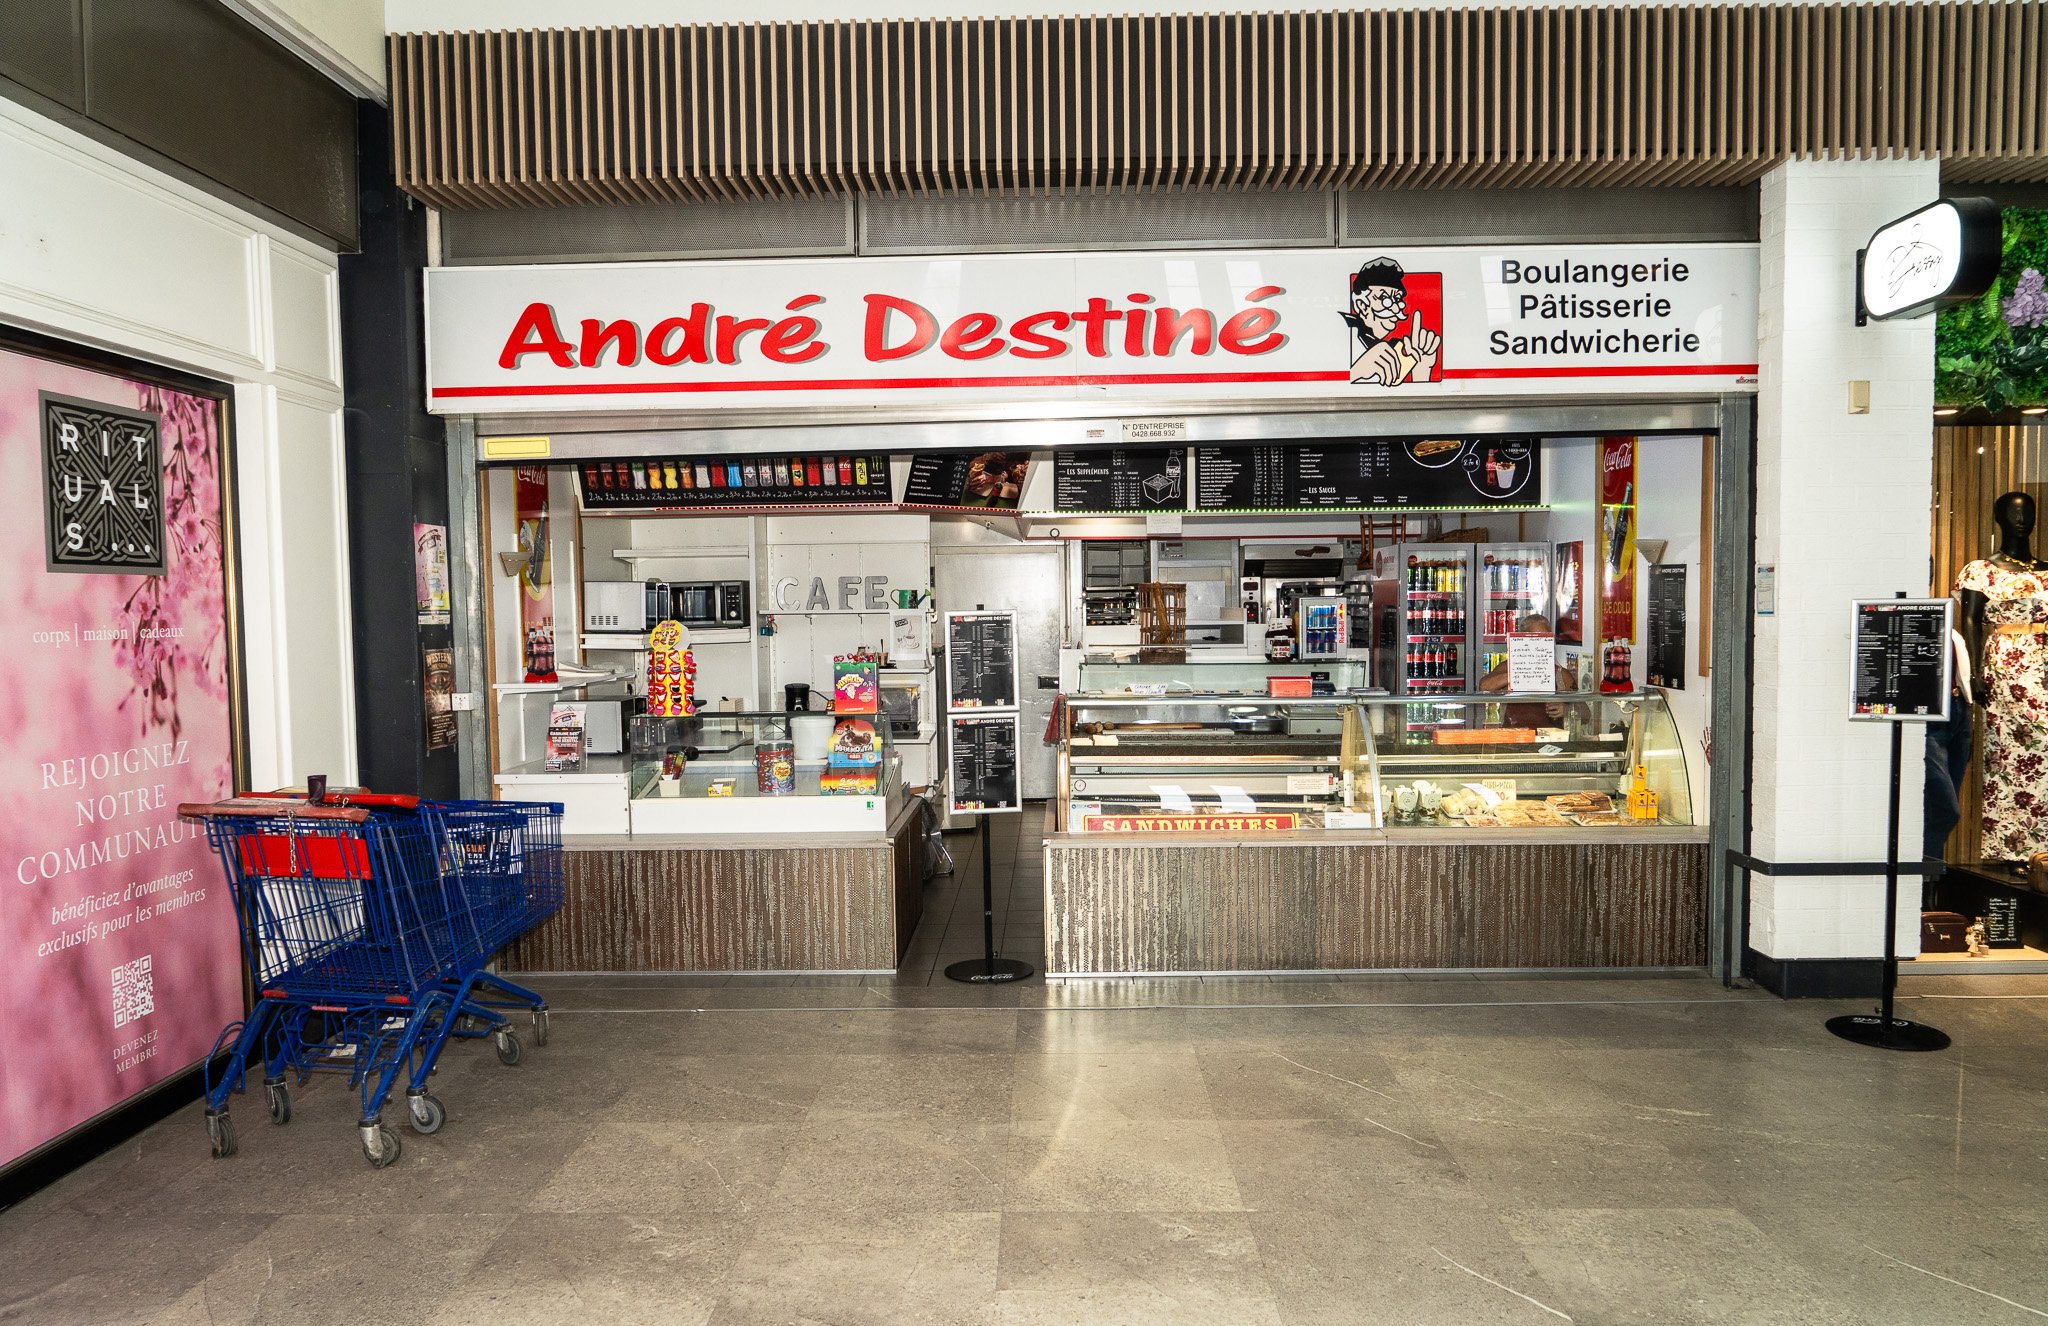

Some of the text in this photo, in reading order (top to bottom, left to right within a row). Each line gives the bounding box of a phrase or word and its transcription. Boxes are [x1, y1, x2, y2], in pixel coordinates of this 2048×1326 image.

[1501, 258, 1690, 287] Boulangerie
[1520, 293, 1672, 320] Pâtisserie
[499, 285, 1288, 370] André Destiné
[1489, 328, 1700, 355] Sandwicherie
[1132, 422, 1185, 430] D'ENTREPRISE
[776, 575, 889, 611] CAFE
[1613, 601, 1631, 613] COLD
[33, 622, 184, 649] corps maison cadeaux
[41, 741, 190, 790] REJOIGNEZ
[76, 784, 167, 827] NOTRE
[1102, 817, 1278, 832] SANDWICHES
[52, 869, 194, 926] bénéficiez d'avantages
[38, 889, 206, 957] exclusifs pour les membres
[113, 1030, 159, 1060] DEVENEZ
[116, 1046, 158, 1075] MEMBRE
